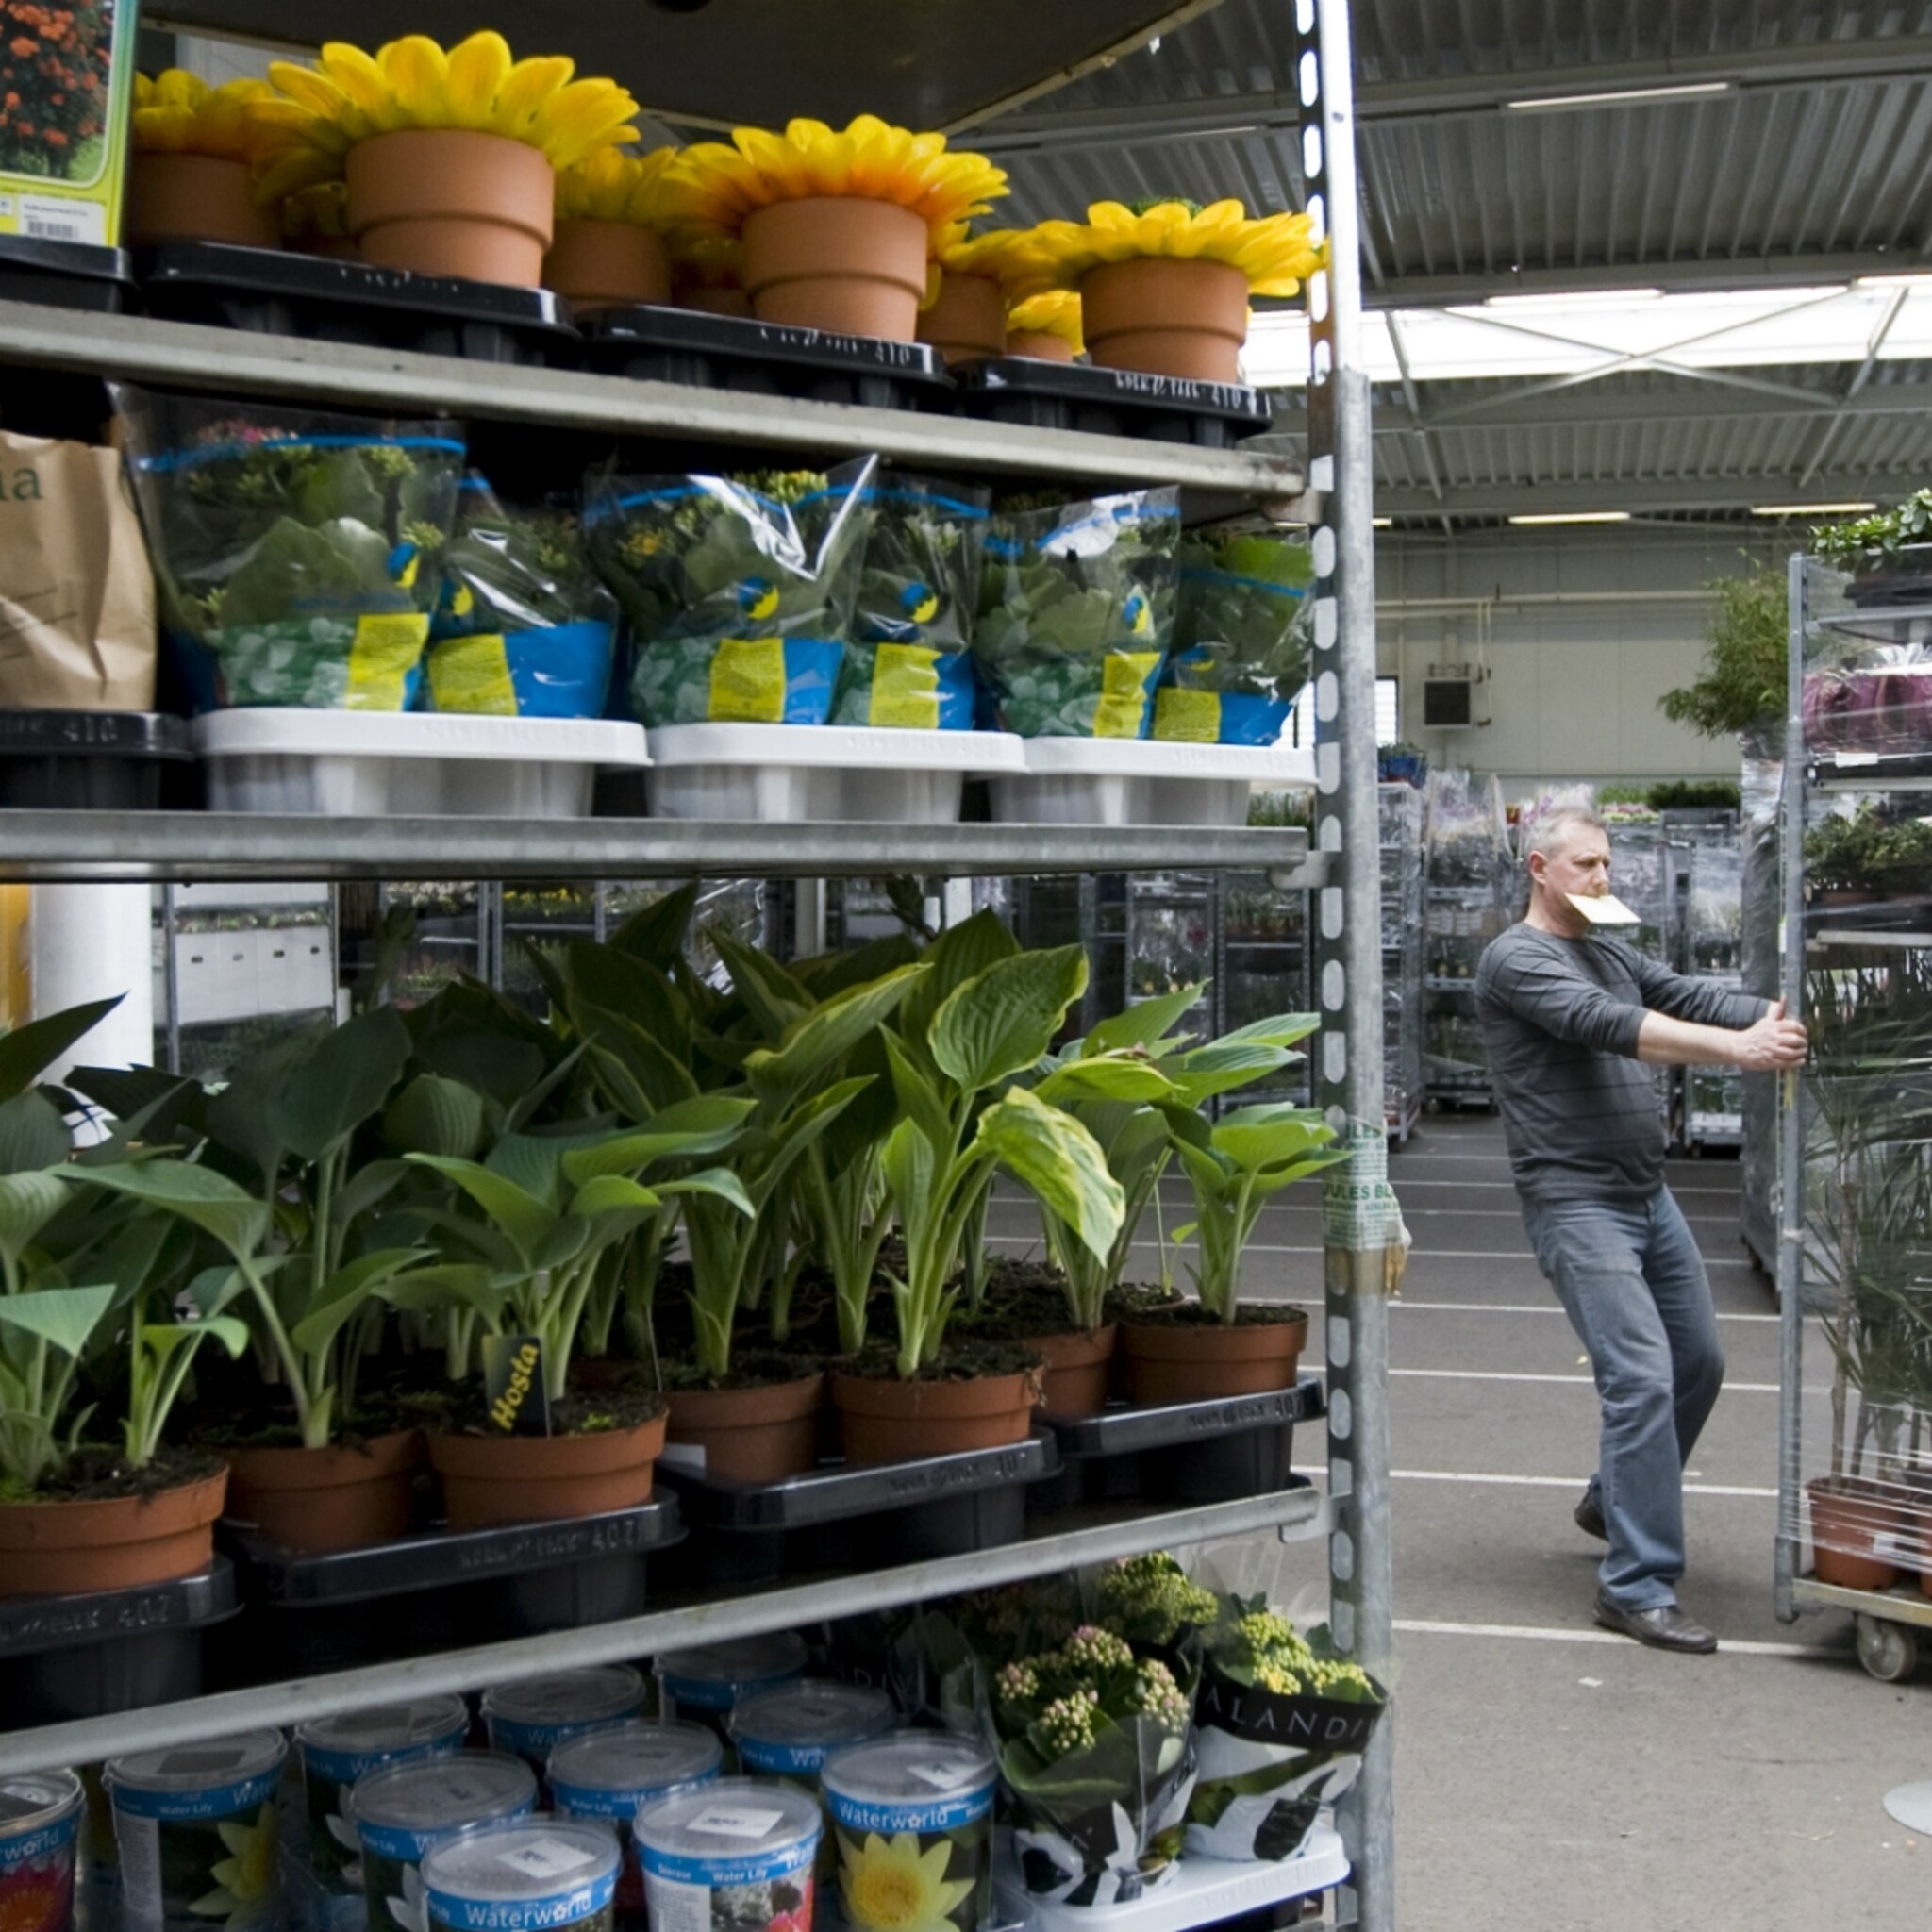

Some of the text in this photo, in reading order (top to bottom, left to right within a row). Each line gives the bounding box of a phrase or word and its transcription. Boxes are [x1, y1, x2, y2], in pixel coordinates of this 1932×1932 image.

[1323, 1181, 1396, 1200] JULES BL
[490, 1342, 541, 1431] Hosta
[1205, 1683, 1376, 1741] ALANDI
[192, 1801, 214, 1816] Lily
[838, 1798, 950, 1830] Waterworld
[746, 1864, 768, 1881] Lily
[462, 1890, 591, 1928] Waterworld
